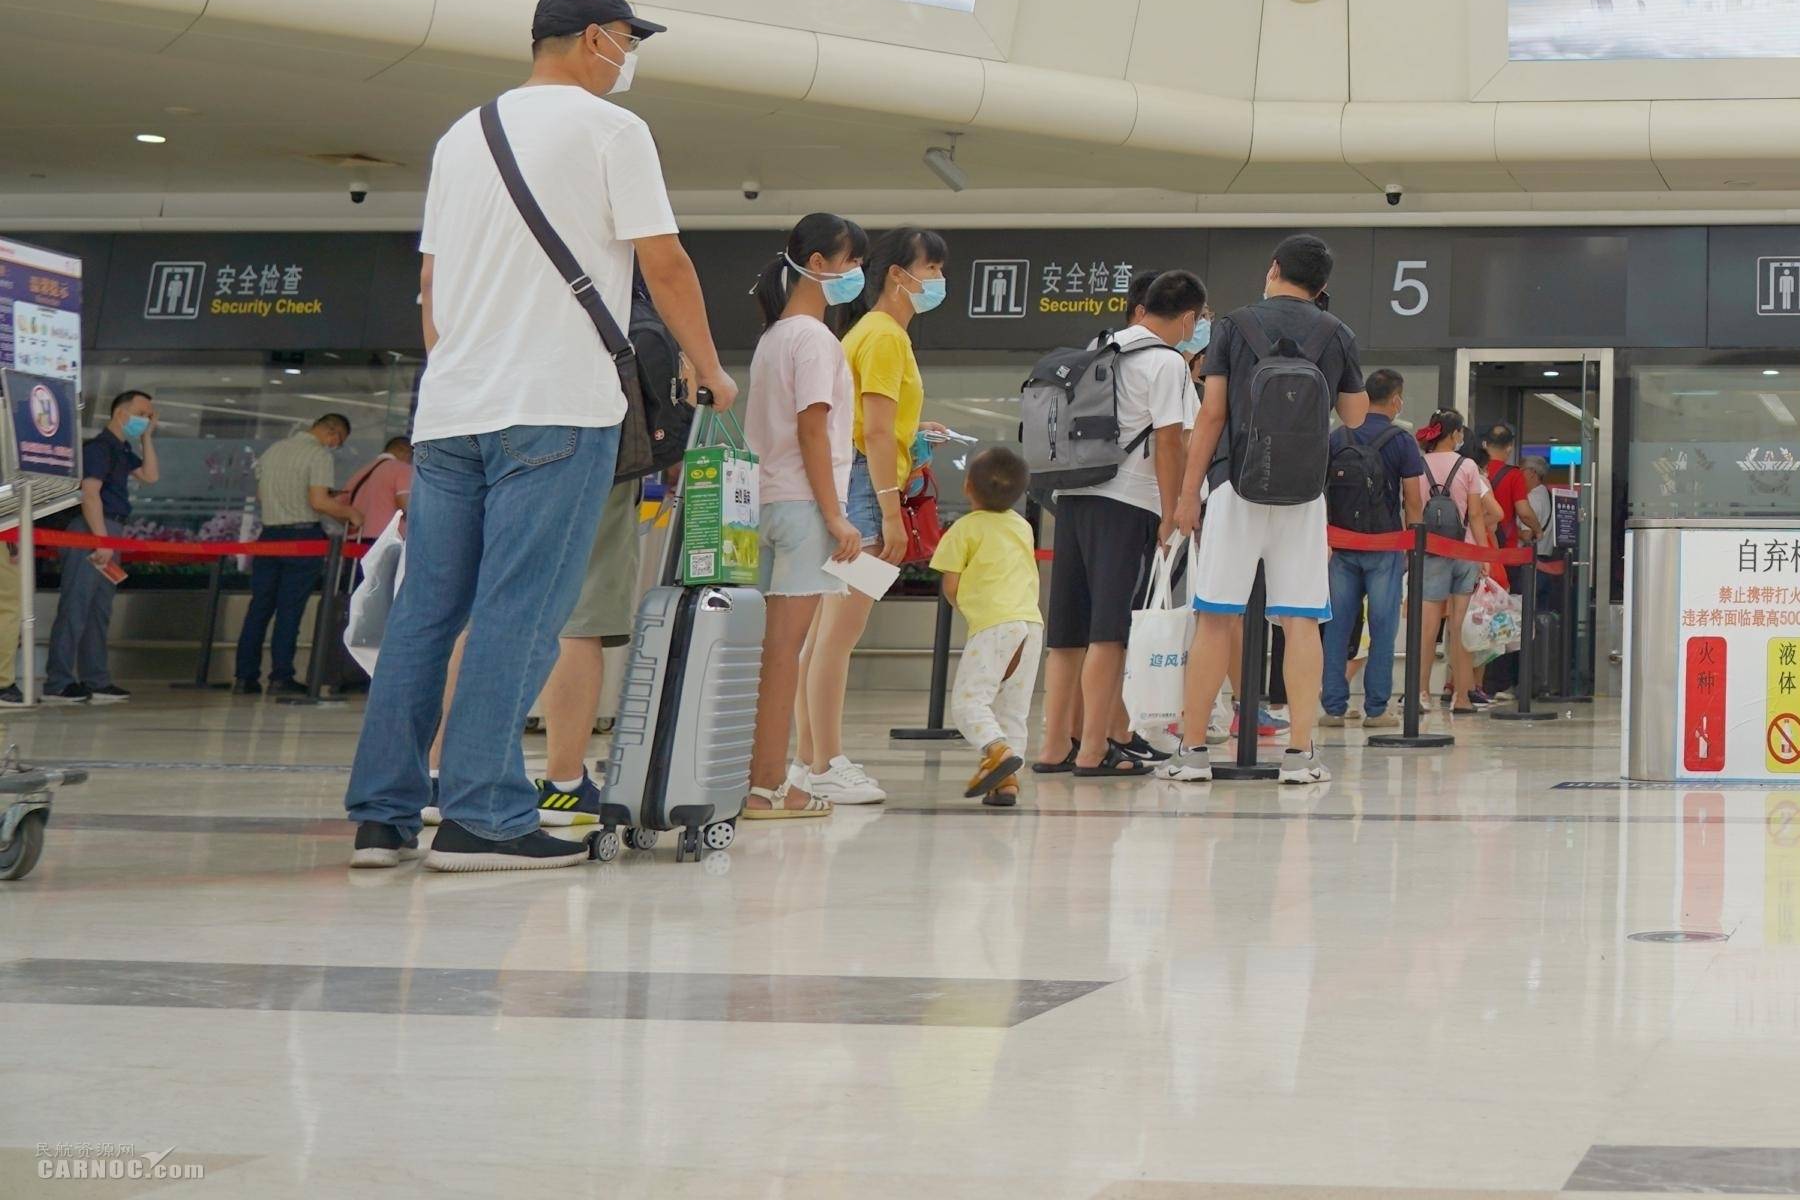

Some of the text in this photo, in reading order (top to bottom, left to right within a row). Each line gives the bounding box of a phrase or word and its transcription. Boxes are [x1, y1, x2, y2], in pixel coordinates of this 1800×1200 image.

[214, 264, 303, 296] 安全检查
[1041, 261, 1133, 294] 安全检查
[1391, 260, 1429, 316] 5
[211, 298, 323, 317] Security Check
[1039, 297, 1104, 316] Security
[1778, 642, 1797, 696] 液体
